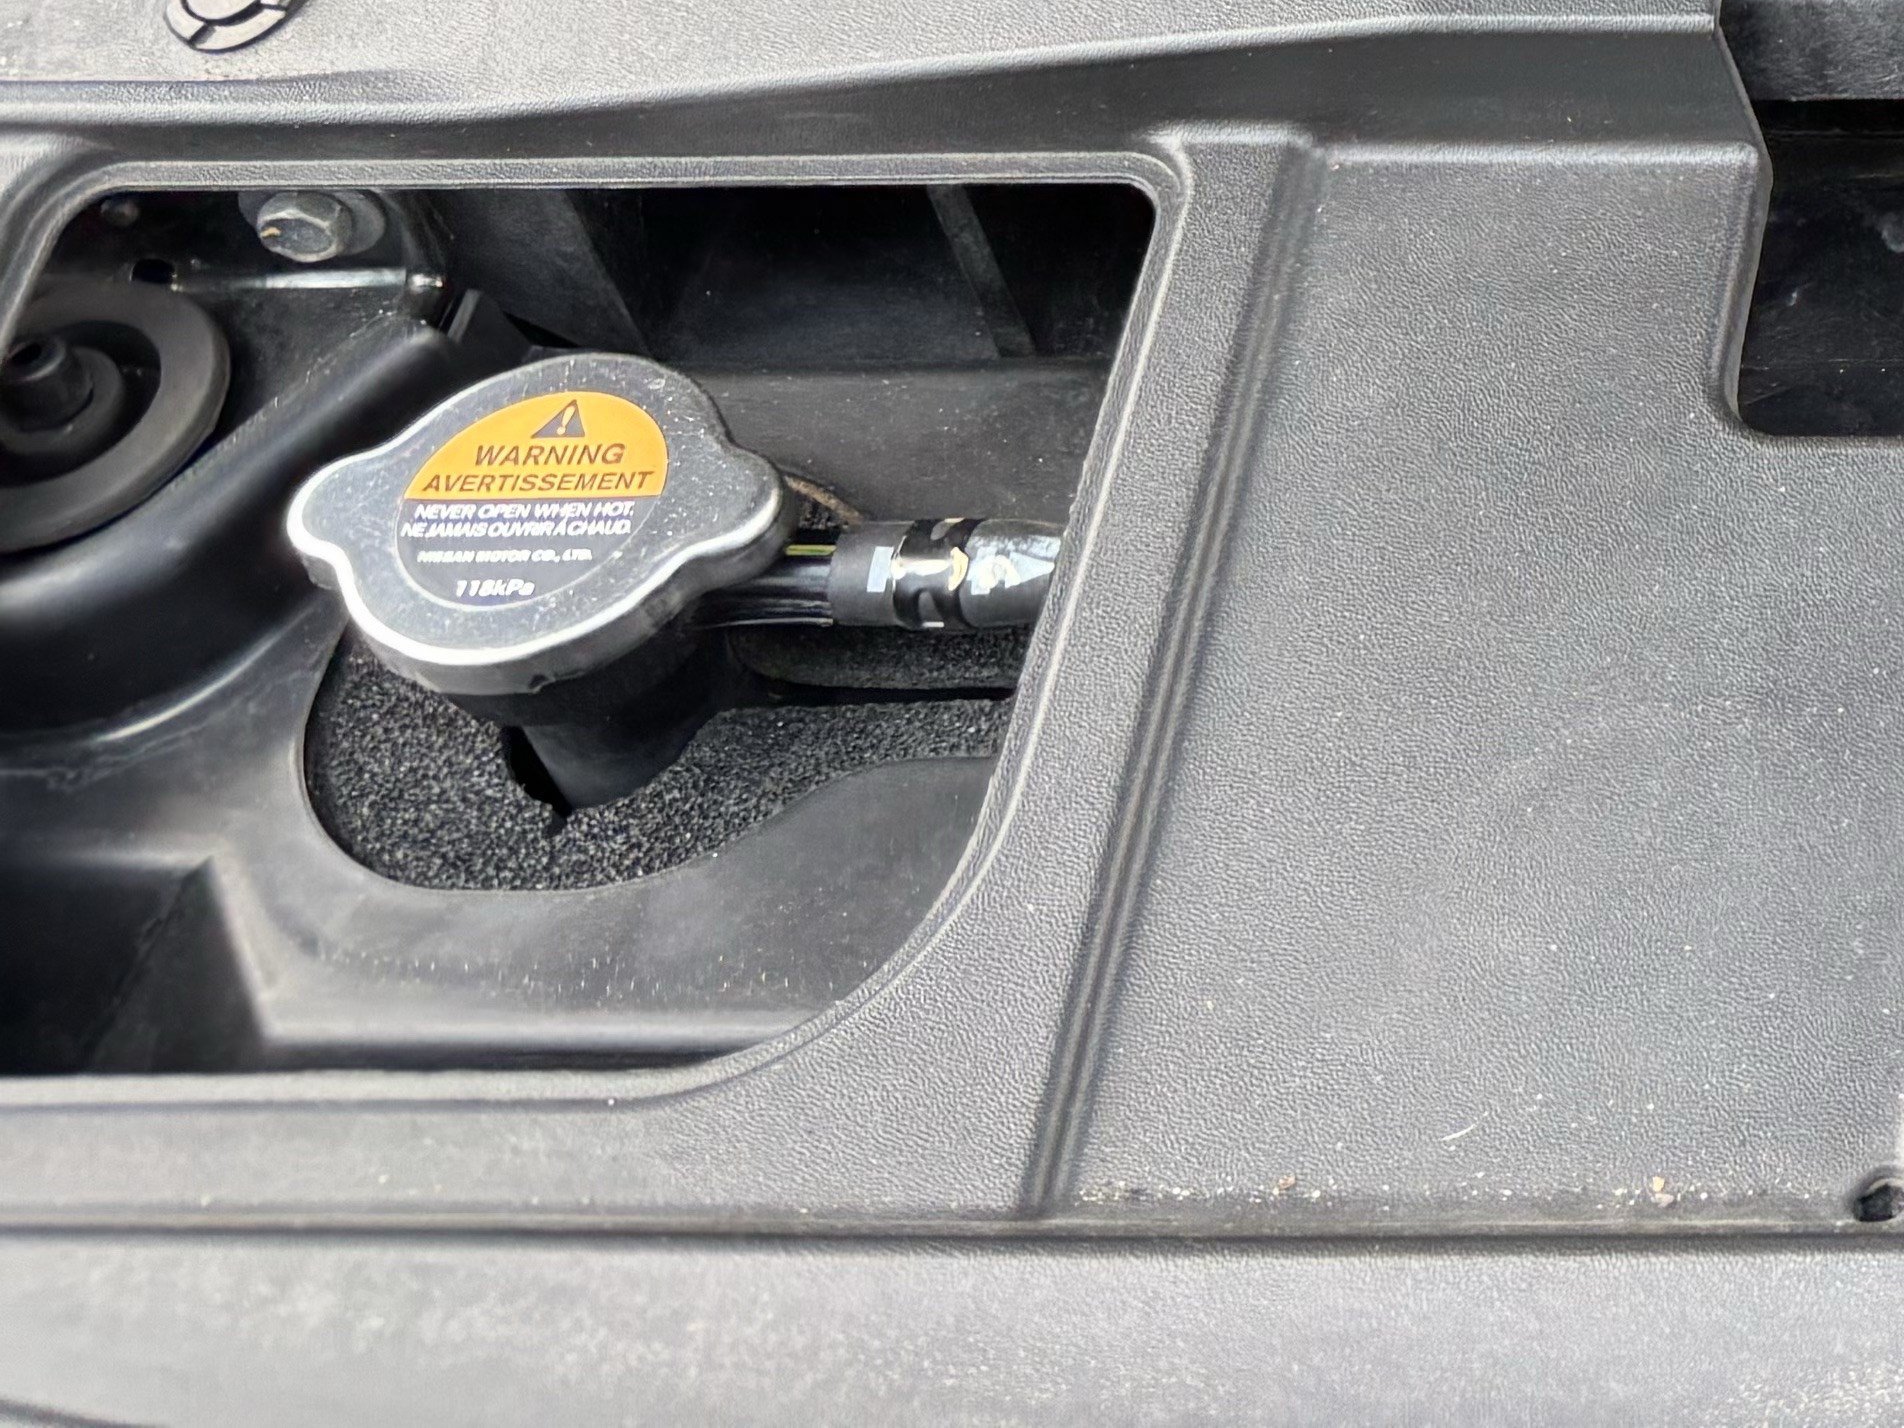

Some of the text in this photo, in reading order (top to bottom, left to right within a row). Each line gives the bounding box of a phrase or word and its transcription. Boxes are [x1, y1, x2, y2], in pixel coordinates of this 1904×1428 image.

[475, 443, 626, 466] WARNING
[422, 470, 655, 492] AVERTISSEMENT
[414, 501, 635, 519] NEVER OPEN WHEN HOT.
[401, 522, 425, 537] NE
[425, 522, 487, 538] JAMAIS
[487, 521, 553, 537] OUVRIR
